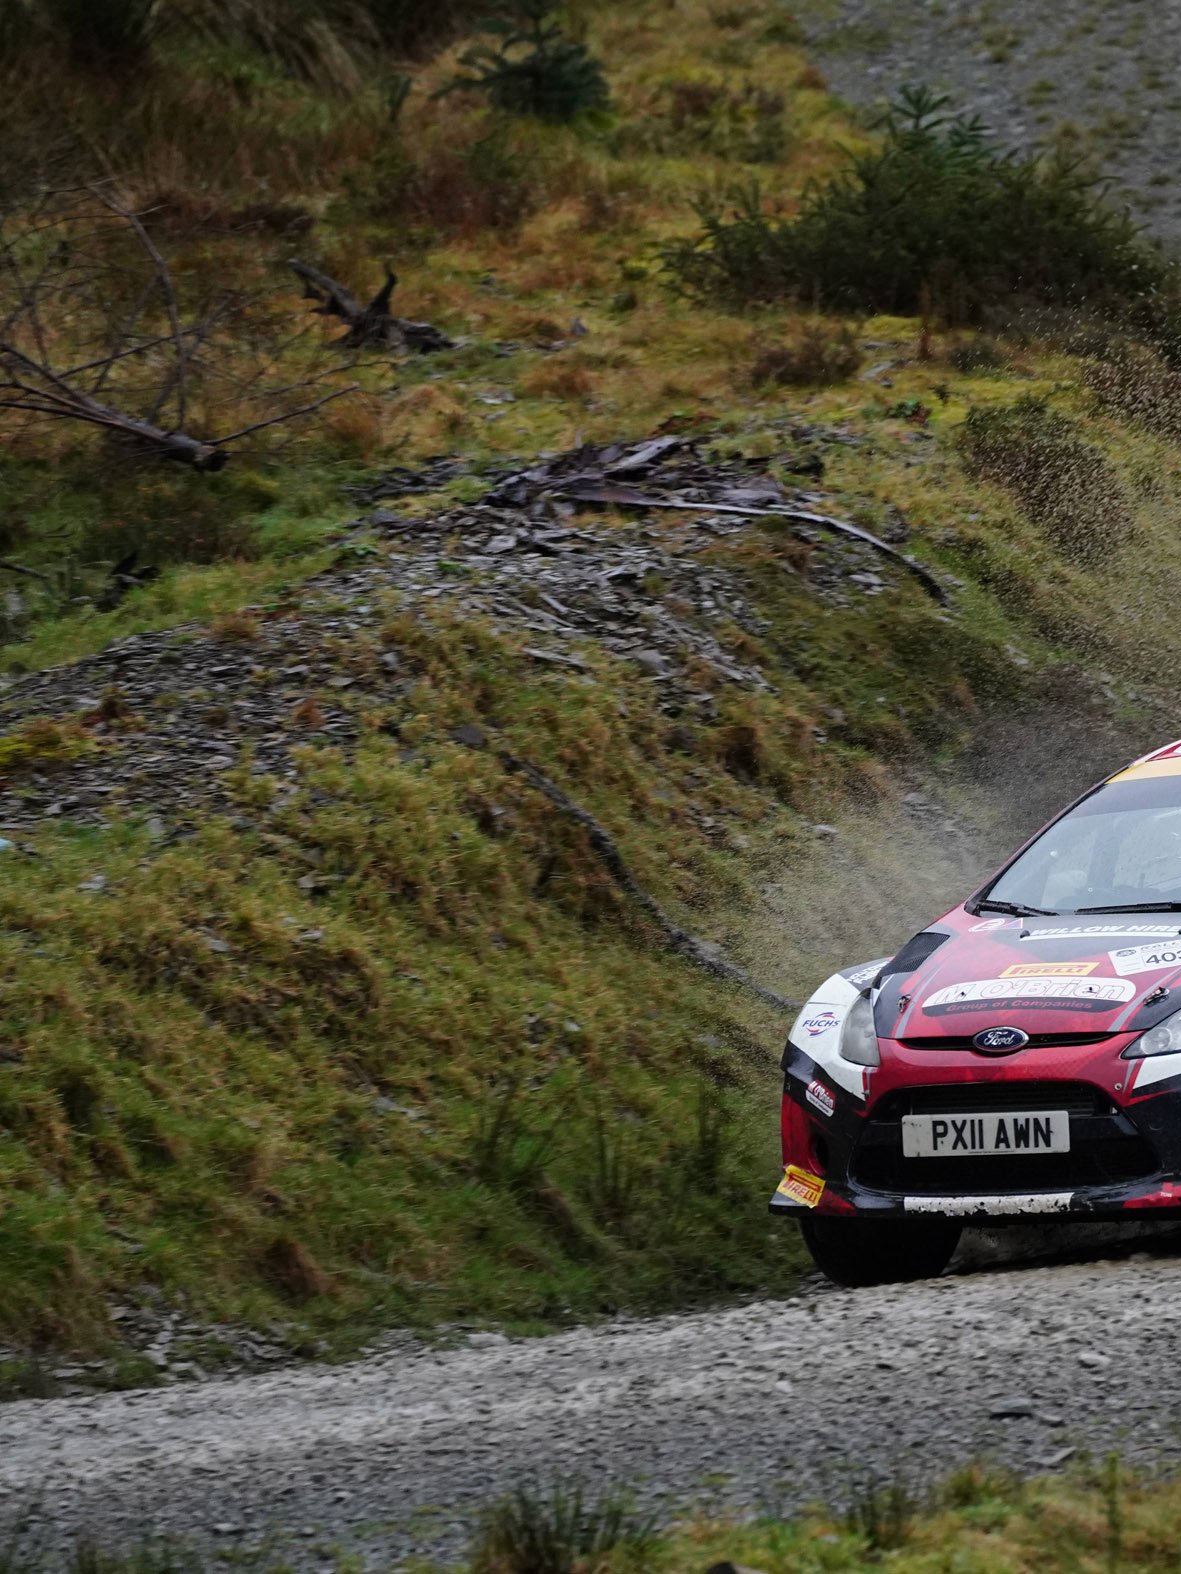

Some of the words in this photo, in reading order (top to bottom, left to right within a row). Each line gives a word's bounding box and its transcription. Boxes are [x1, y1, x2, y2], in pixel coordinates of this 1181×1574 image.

[1031, 925, 1126, 936] WILLOW
[1013, 965, 1085, 976] PIRELLI
[946, 1002, 989, 1012] Group
[992, 1000, 1008, 1008] of
[1011, 999, 1092, 1009] Companies
[802, 1019, 840, 1027] FUCHS
[984, 1031, 1015, 1045] Ford
[994, 1117, 1052, 1149] AWN
[782, 1172, 821, 1202] PIRELLI
